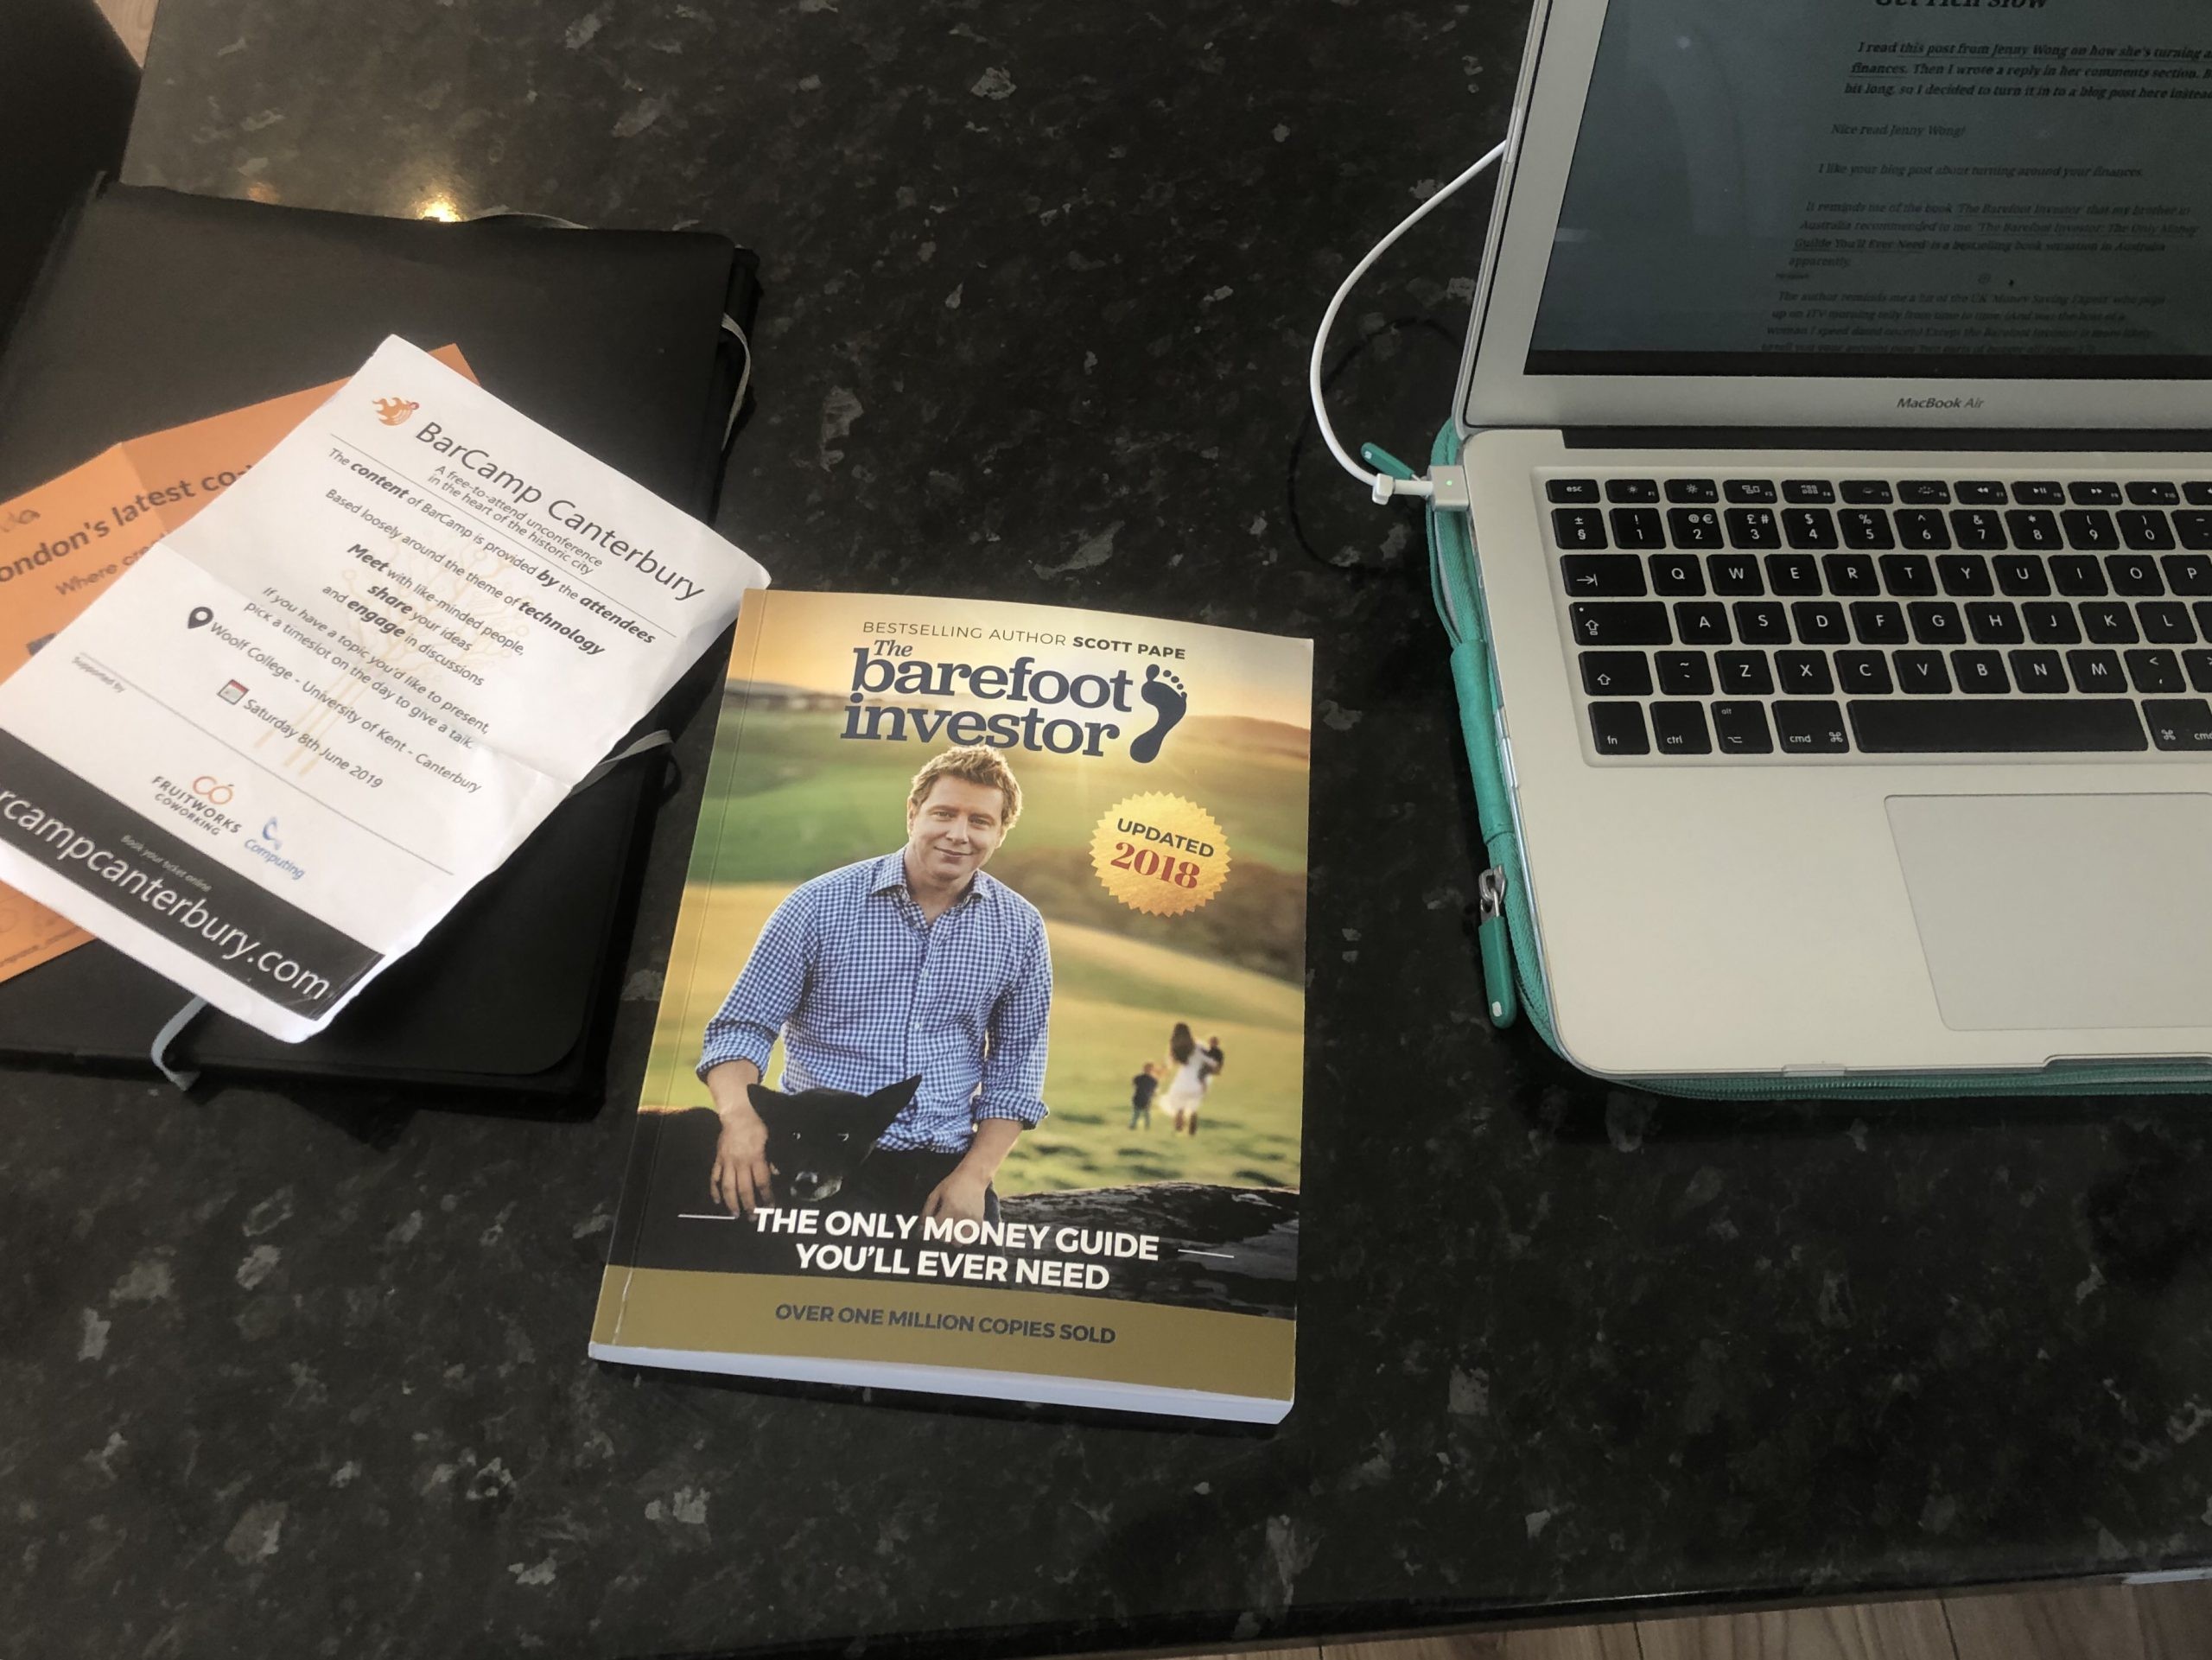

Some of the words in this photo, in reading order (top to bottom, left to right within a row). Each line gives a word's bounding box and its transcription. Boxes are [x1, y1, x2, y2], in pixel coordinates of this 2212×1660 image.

[1866, 41, 1897, 53] read
[1900, 41, 1923, 53] this
[1927, 43, 1956, 56] post
[1957, 42, 1990, 55] from
[1991, 43, 2029, 58] Jenny
[2033, 44, 2069, 60] Wong
[2070, 46, 2087, 55] on
[2089, 44, 2116, 56] how
[2118, 44, 2152, 57] she's
[2153, 46, 2202, 61] turning
[1897, 398, 1961, 409] MacBook
[1964, 398, 1985, 409] Air
[111, 480, 196, 527] latest
[416, 422, 543, 504] BarCamp
[548, 499, 705, 602] Canterbury
[435, 465, 446, 475] A
[446, 471, 529, 521] free-to-attend
[526, 519, 603, 567] unconference
[428, 474, 440, 487] in
[441, 480, 462, 497] the
[462, 492, 493, 517] heart
[493, 511, 510, 525] of
[507, 519, 528, 536] the
[527, 526, 571, 562] historic
[571, 557, 594, 576] city
[328, 448, 350, 466] The
[350, 462, 410, 499] content
[406, 495, 423, 509] of
[420, 502, 474, 539] BarCamp
[474, 533, 485, 545] is
[484, 542, 539, 576] provided
[535, 569, 560, 588] by
[557, 583, 579, 600] the
[580, 595, 657, 645] attendees
[55, 563, 118, 595] Where
[325, 488, 362, 513] Based
[360, 508, 402, 539] loosely
[402, 535, 444, 563] around
[444, 559, 465, 576] the
[464, 571, 505, 599] theme
[503, 593, 519, 607] of
[517, 601, 606, 656] technology
[1671, 568, 1685, 580] Q
[1728, 567, 1744, 580] W
[1789, 567, 1800, 579] E
[1847, 567, 1859, 579] R
[1904, 567, 1912, 579] T
[1961, 567, 1970, 579] Y
[2016, 568, 2029, 580] U
[2076, 567, 2082, 579] I
[2130, 567, 2143, 580] O
[2186, 567, 2197, 580] P
[346, 543, 390, 573] Meet
[386, 568, 414, 589] with
[412, 583, 485, 631] like-minded
[480, 625, 524, 656] people,
[367, 583, 413, 614] share
[410, 610, 440, 632] your
[439, 627, 474, 652] ideas
[1699, 615, 1711, 628] A
[1758, 614, 1769, 627] S
[1815, 614, 1828, 627] D
[1876, 614, 1885, 626] F
[1932, 614, 1945, 627] G
[1988, 614, 2003, 626] H
[2050, 614, 2057, 627] J
[2103, 614, 2117, 626] K
[2162, 614, 2173, 626] L
[321, 585, 349, 604] and
[346, 600, 406, 638] engage
[404, 633, 418, 647] in
[417, 641, 485, 687] discussions
[862, 620, 982, 639] BESTSELLING
[988, 628, 1066, 646] AUTHOR
[1072, 636, 1133, 654] SCOTT
[1137, 643, 1186, 659] PAPE
[873, 639, 913, 658] The
[262, 586, 276, 598] If
[273, 593, 298, 614] you
[298, 607, 327, 632] have
[327, 628, 338, 639] a
[337, 633, 370, 659] topic
[368, 654, 404, 680] you'd
[404, 674, 428, 695] like
[427, 690, 442, 703] to
[440, 699, 489, 735] present,
[72, 656, 115, 686] Supported
[114, 679, 126, 693] by
[243, 601, 273, 621] pick
[271, 617, 283, 628] a
[282, 623, 332, 660] timeslot
[331, 654, 350, 670] on
[349, 665, 372, 684] the
[371, 680, 396, 700] day
[394, 694, 410, 709] to
[409, 705, 438, 727] give
[437, 722, 448, 734] a
[448, 728, 474, 749] talk.
[1739, 665, 1751, 677] Z
[1800, 664, 1813, 677] X
[1859, 664, 1872, 677] C
[1916, 663, 1928, 676] V
[1976, 663, 1988, 677] B
[2033, 663, 2048, 676] N
[2091, 663, 2107, 676] M
[851, 647, 1134, 713] barefoot
[209, 621, 251, 651] Woolf
[247, 646, 294, 681] College
[301, 680, 363, 726] University
[361, 719, 378, 732] of
[376, 725, 407, 753] Kent
[414, 751, 482, 793] Canterbury
[840, 692, 1120, 758] investor
[243, 698, 300, 739] Saturday
[297, 733, 321, 754] 8th
[318, 747, 350, 771] June
[348, 765, 385, 790] 2019
[1606, 735, 1618, 745] fn
[1666, 735, 1683, 745] ctrl
[1789, 734, 1812, 743] cmd
[152, 775, 243, 834] FRUITWORKS
[154, 792, 221, 836] COWORKING
[1117, 817, 1215, 858] UPDATED
[121, 834, 145, 852] Book
[142, 847, 164, 864] your
[162, 861, 188, 879] ticket
[185, 874, 213, 893] online
[244, 838, 305, 881] Computing
[1110, 842, 1200, 889] 2018
[753, 1207, 818, 1235] THE
[824, 1210, 918, 1241] ONLY
[922, 1215, 1051, 1250] MONEY
[1054, 1226, 1160, 1262] GUIDE
[917, 1250, 1007, 1282] EVER
[1014, 1256, 1110, 1291] NEED
[774, 1302, 835, 1322] OVER
[838, 1307, 884, 1326] ONE
[888, 1310, 975, 1332] MILLION
[978, 1316, 1056, 1339] COPIES
[1059, 1323, 1116, 1345] SOLD
